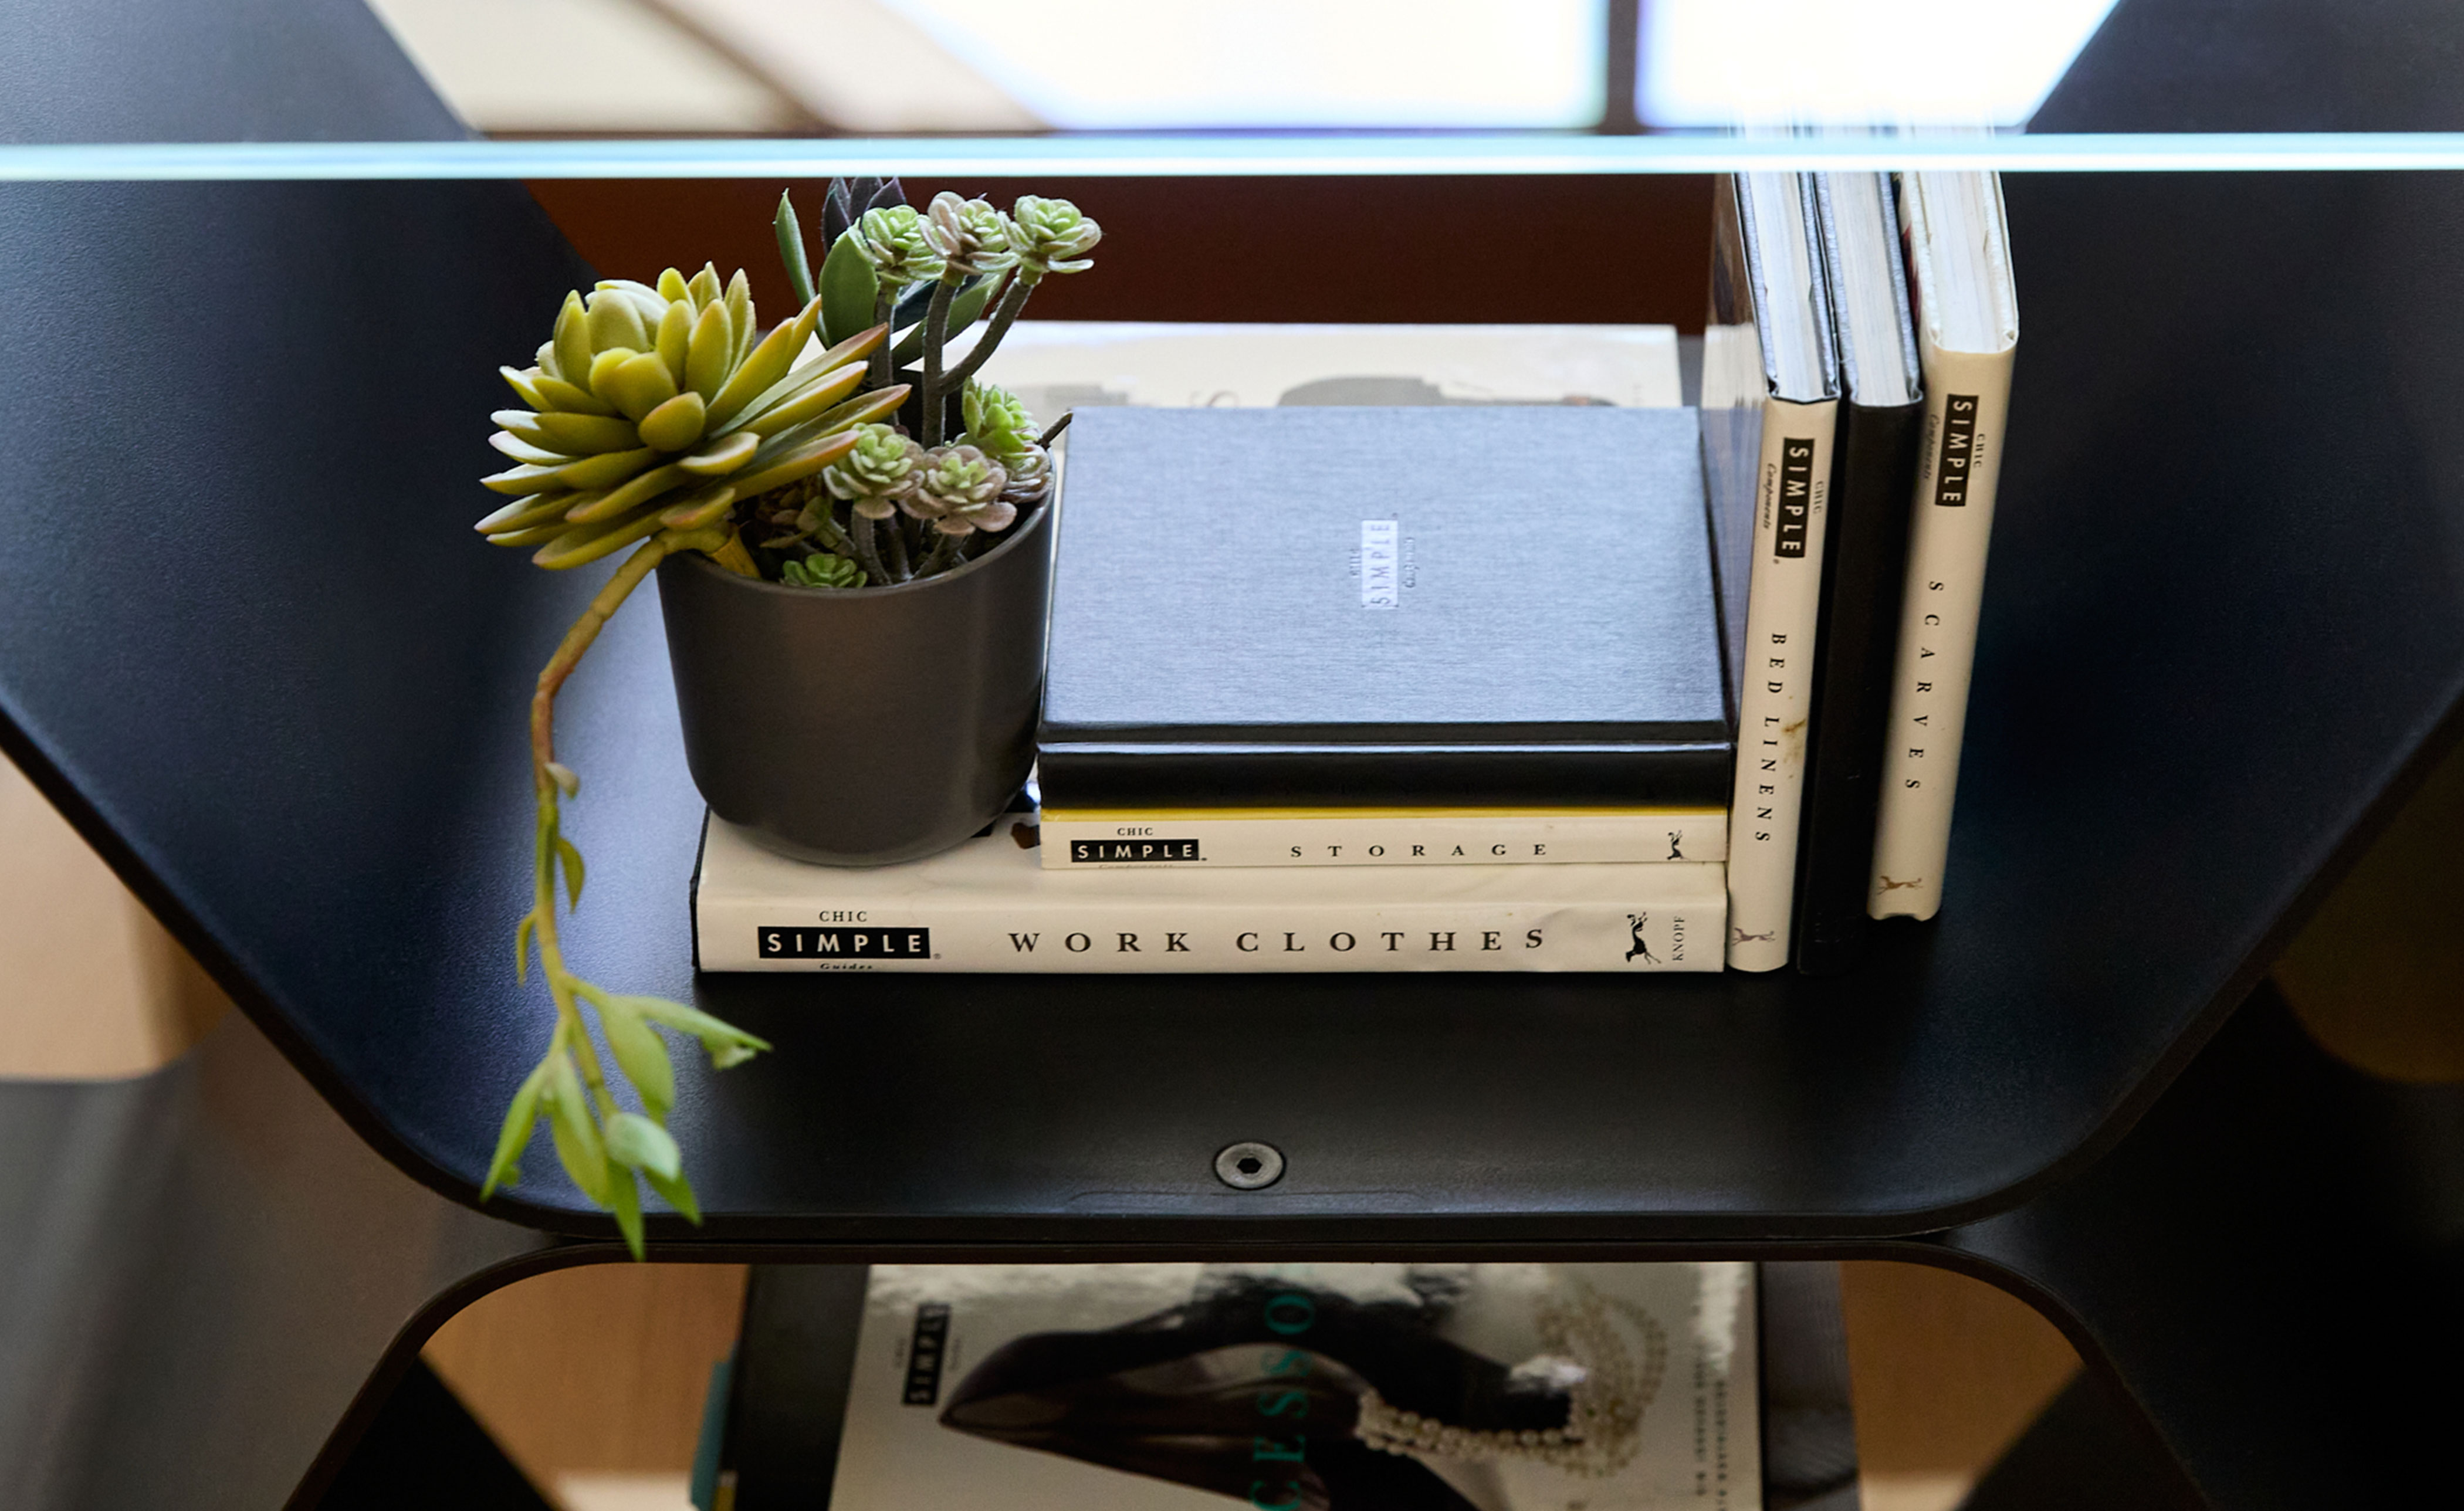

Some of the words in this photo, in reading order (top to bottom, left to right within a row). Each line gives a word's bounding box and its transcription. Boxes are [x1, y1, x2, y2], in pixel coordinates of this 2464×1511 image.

[1942, 400, 1974, 502] SIMPLE
[1972, 433, 1986, 468] CHIC
[1781, 446, 1809, 551] SIMPLE
[1813, 480, 1825, 514] CHIC
[1767, 633, 1787, 694] BED
[1905, 581, 1945, 789] SCARVES
[1755, 716, 1780, 842] LINENS
[1116, 827, 1154, 836] CHIC
[1078, 843, 1193, 859] SIMPLE
[1290, 843, 1546, 858] STORAGE
[818, 911, 868, 923] CHIC
[767, 933, 922, 953] SIMPLE
[1008, 932, 1191, 953] WORK
[1236, 929, 1543, 953] CLOTHES
[1672, 916, 1685, 961] KNOPF
